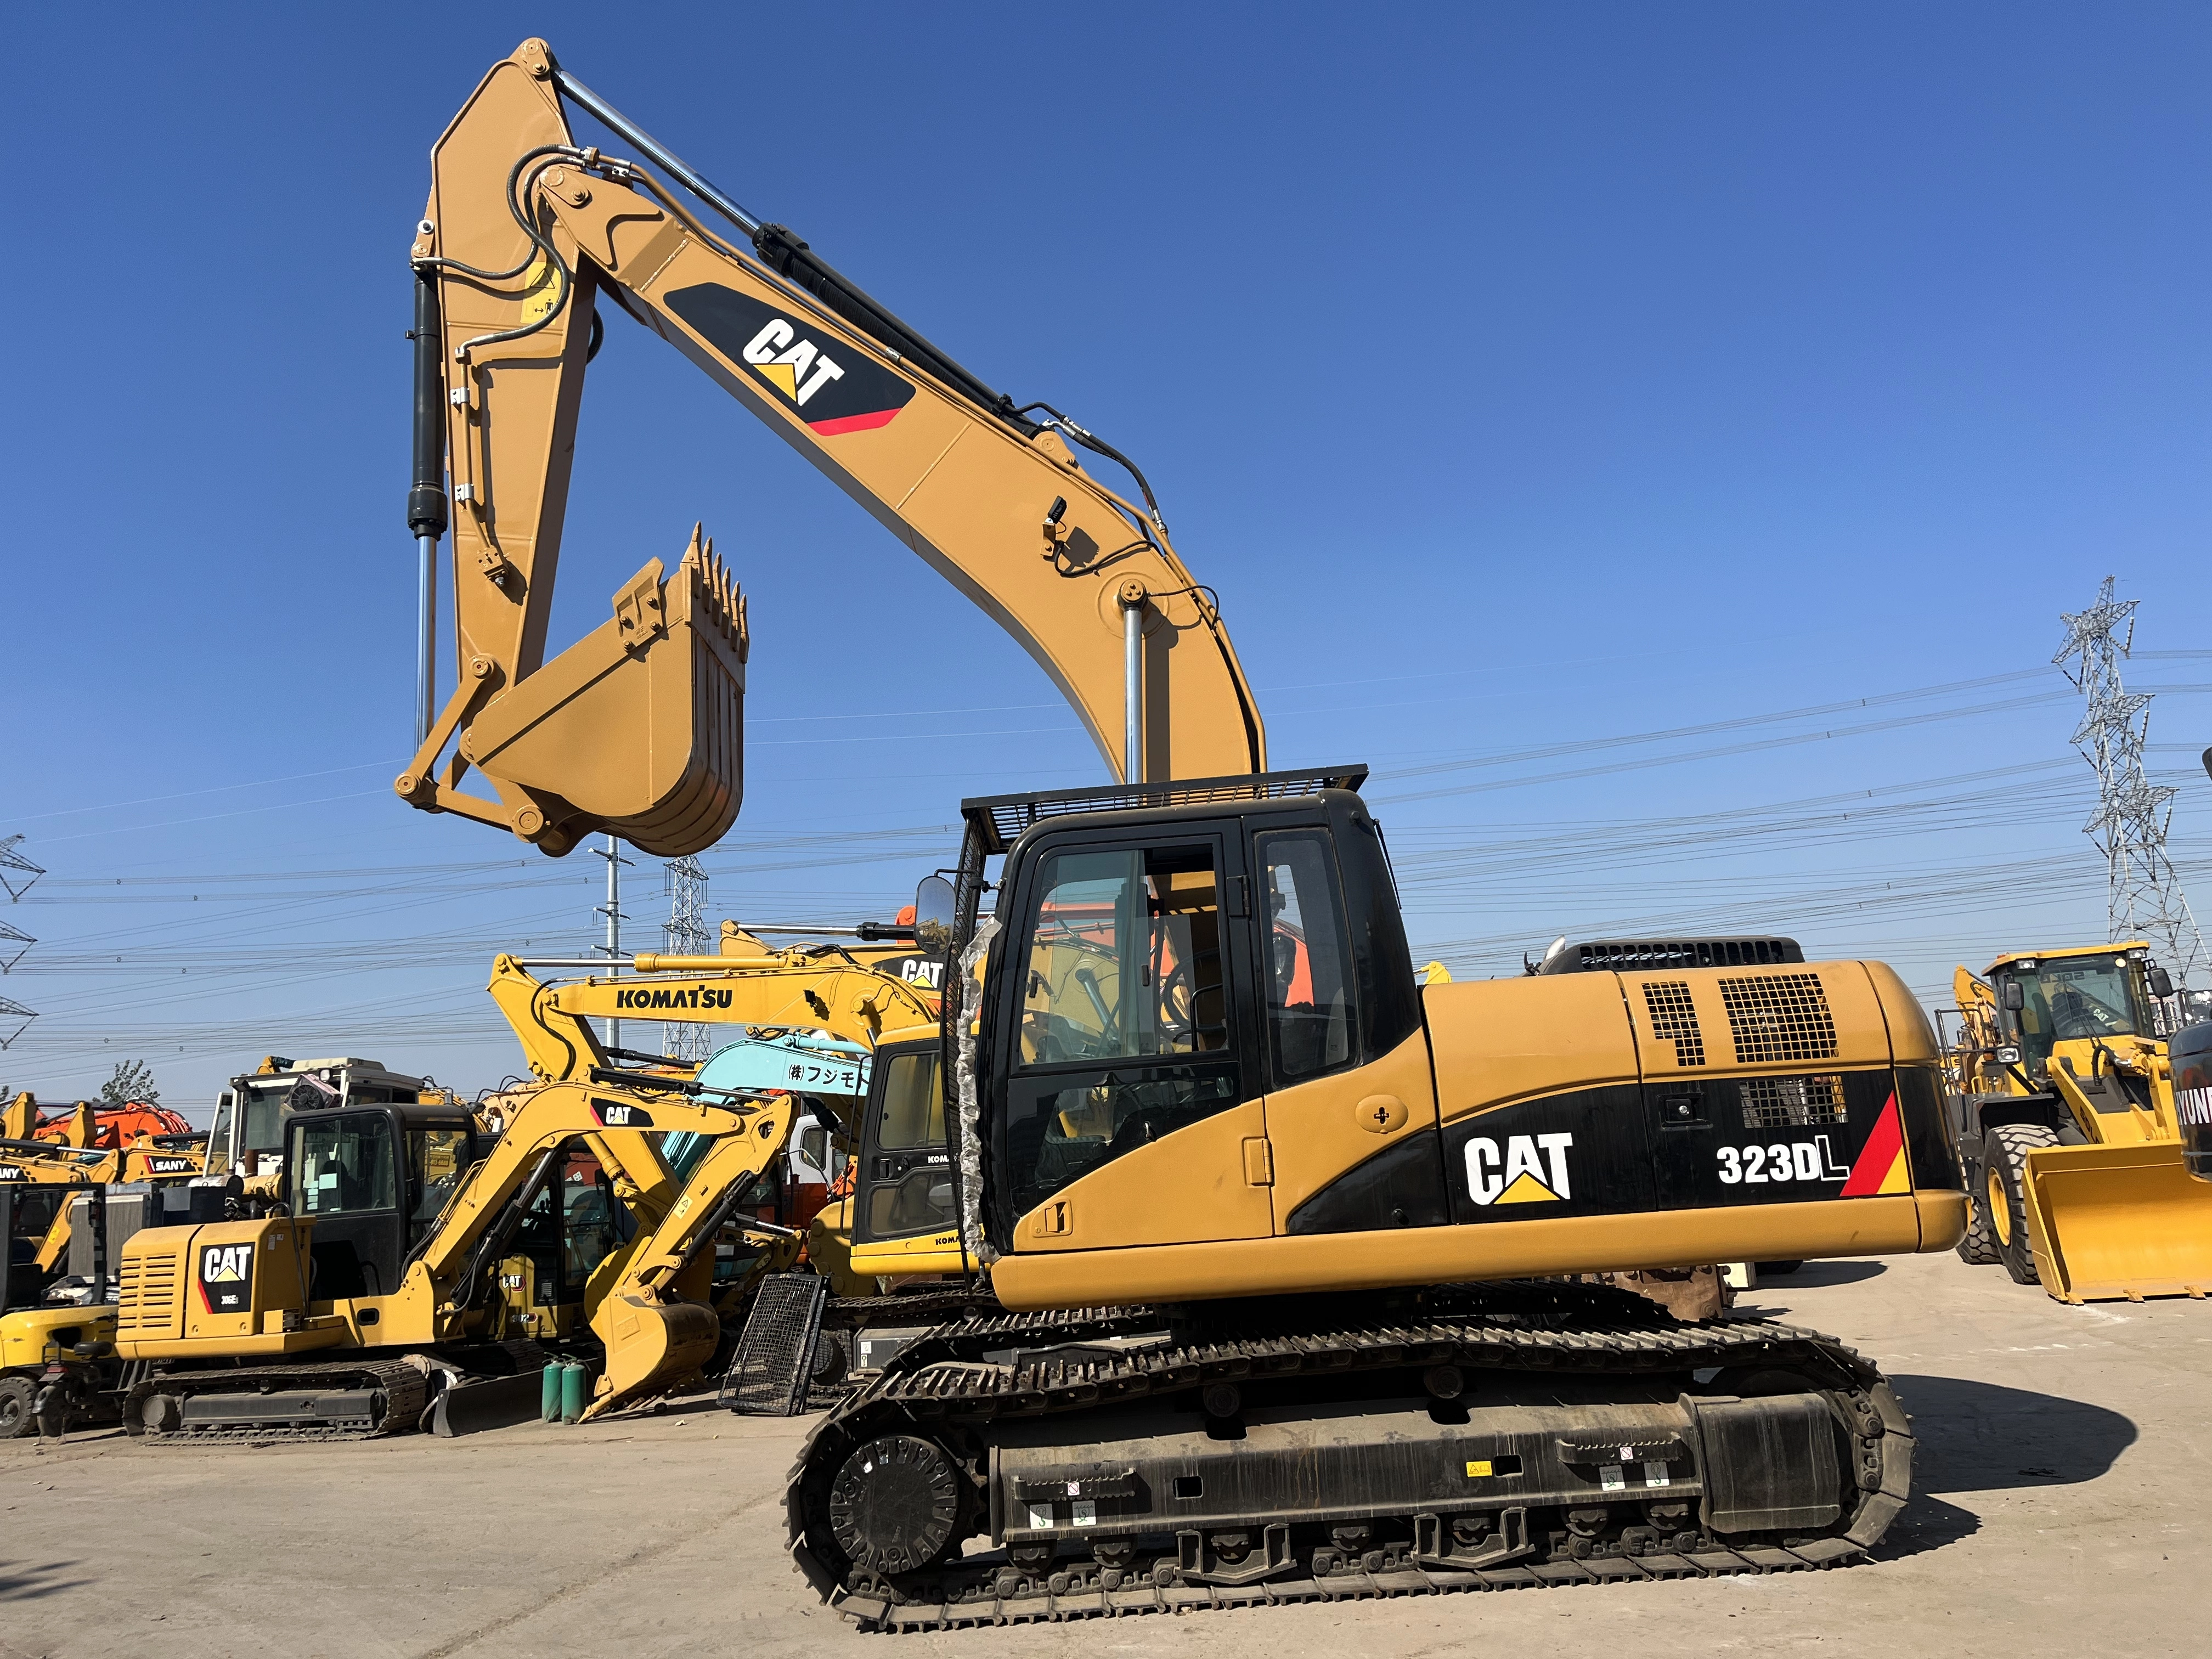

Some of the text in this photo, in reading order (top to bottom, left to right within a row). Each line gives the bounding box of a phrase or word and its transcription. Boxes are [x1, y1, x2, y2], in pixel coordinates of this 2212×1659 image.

[743, 318, 845, 407] CAT
[901, 959, 944, 989] CAT
[616, 984, 733, 1008] KOMATSU
[606, 1107, 631, 1125] CAT
[155, 1160, 187, 1171] SANY
[928, 1155, 949, 1164] KOM
[1464, 1132, 1573, 1205] CAT
[1717, 1135, 1850, 1184] 323DL
[204, 1246, 251, 1283] CAT
[503, 1276, 521, 1289] CAT
